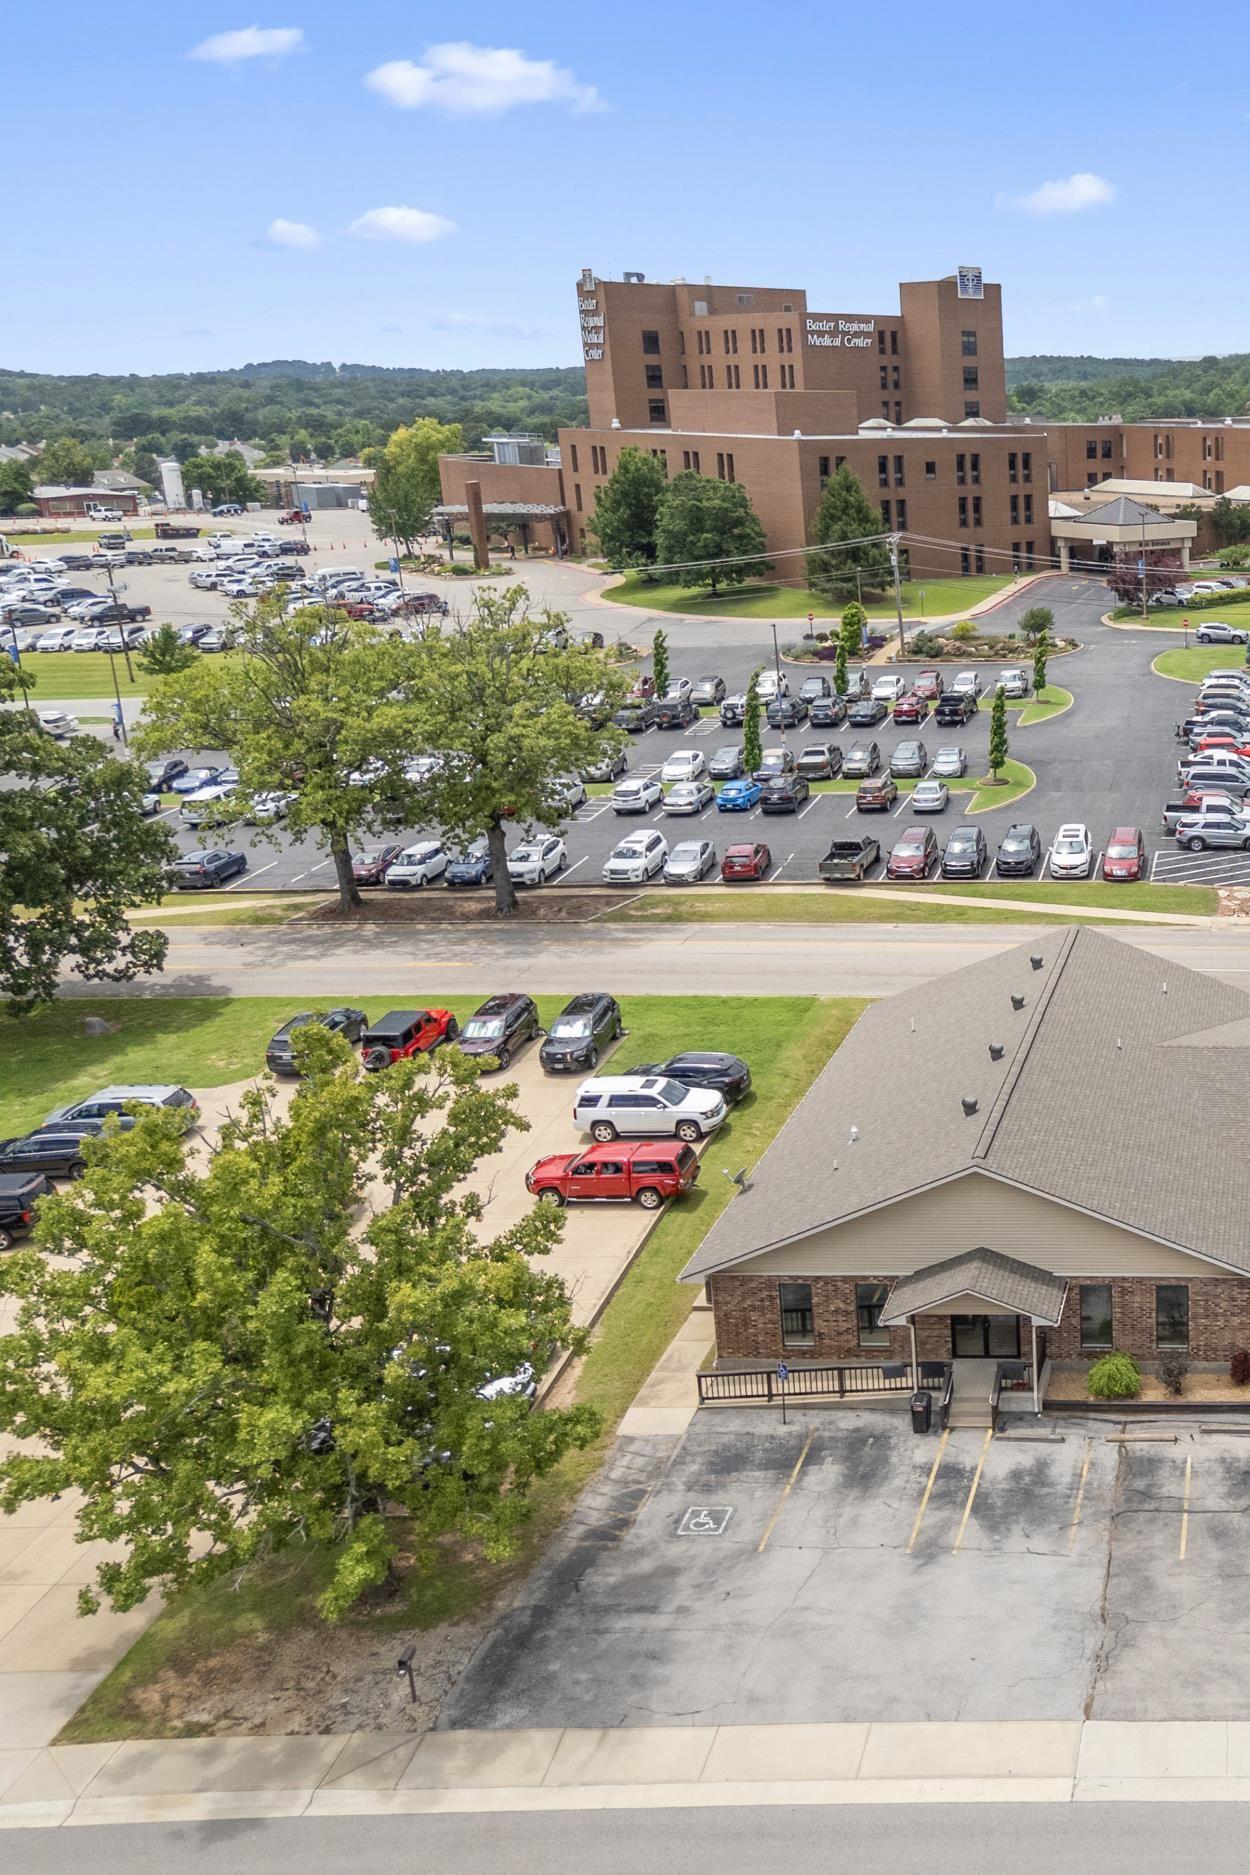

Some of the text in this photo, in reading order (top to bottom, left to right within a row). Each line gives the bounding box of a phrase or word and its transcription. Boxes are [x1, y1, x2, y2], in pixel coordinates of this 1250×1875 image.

[579, 297, 597, 310] Baxter
[581, 312, 604, 330] Regional
[806, 319, 875, 334] Baxter Regional
[583, 328, 604, 344] Medical
[808, 334, 872, 347] Medical Center
[584, 347, 603, 360] Center
